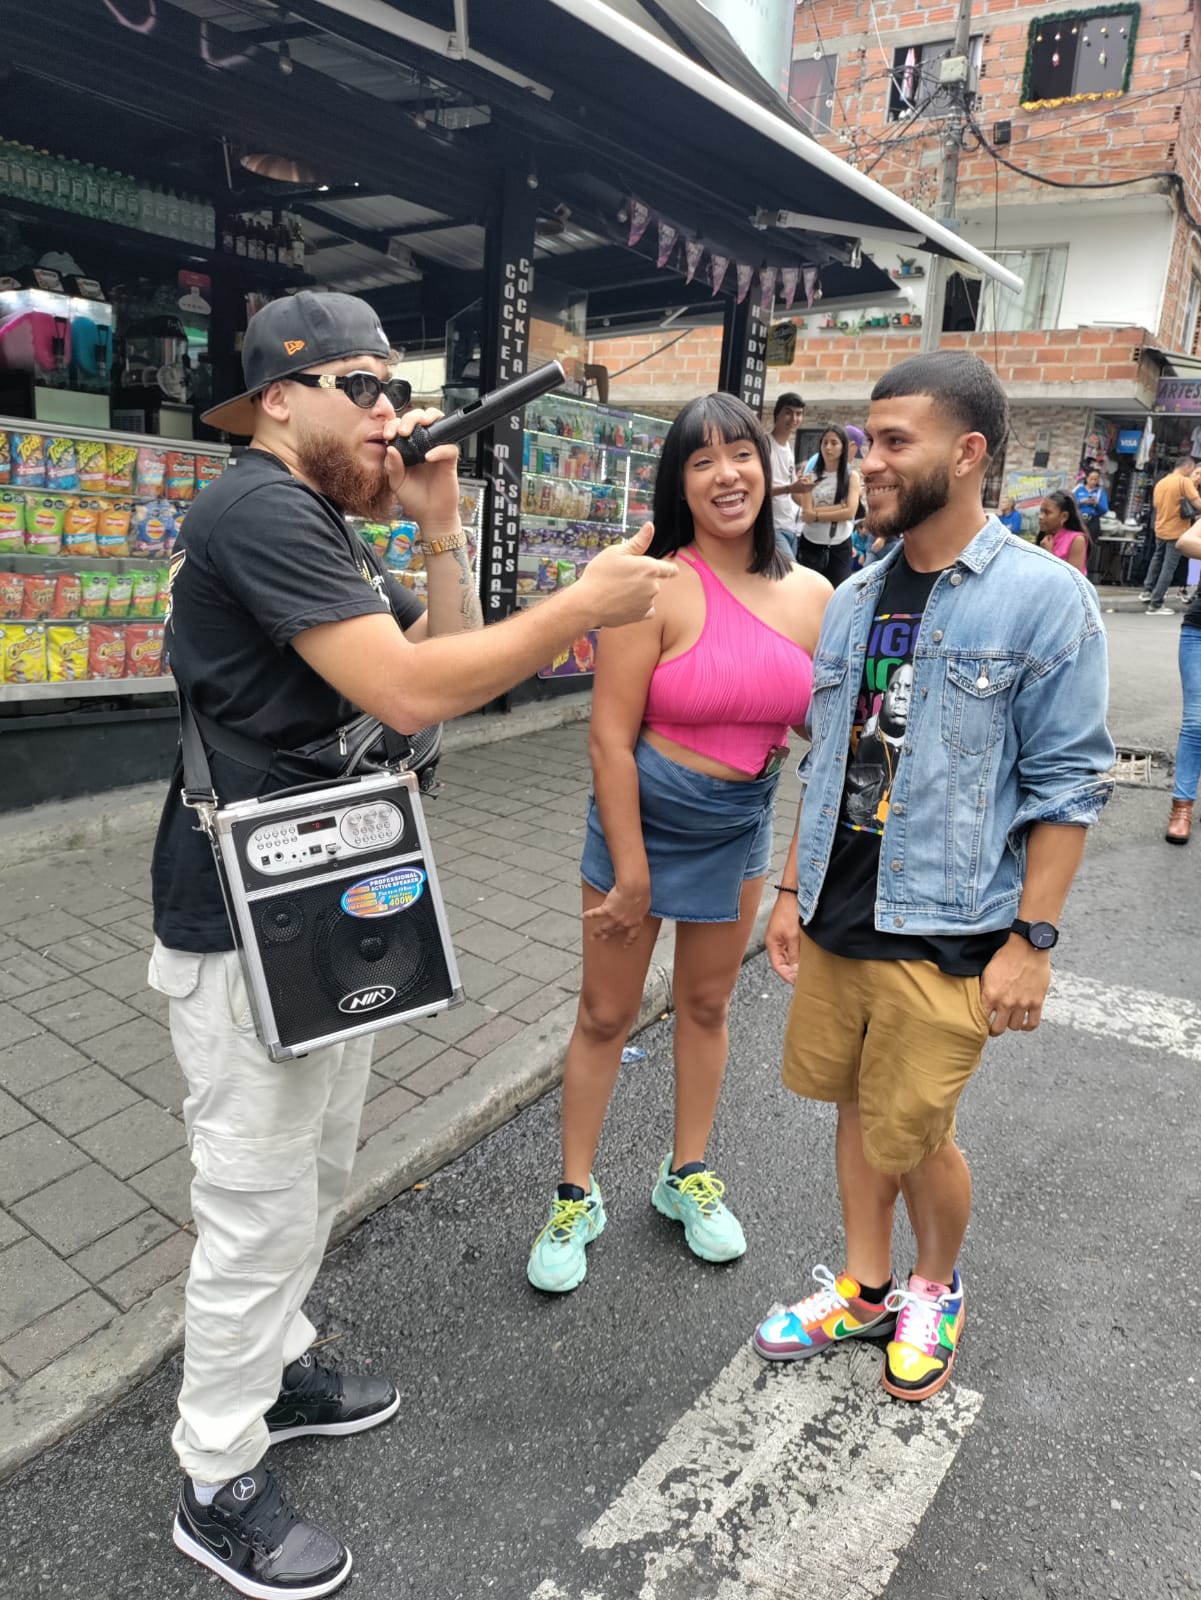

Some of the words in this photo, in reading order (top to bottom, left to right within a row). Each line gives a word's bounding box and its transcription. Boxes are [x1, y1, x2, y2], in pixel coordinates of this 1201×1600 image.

[500, 263, 516, 380] CÓCTEL
[510, 258, 529, 430] COCKTAS
[743, 305, 761, 404] HIDRAT
[751, 325, 768, 412] HYDRA
[490, 443, 510, 609] MICHELADAS
[504, 484, 519, 573] SHOTS
[370, 872, 418, 886] PROFESSIONAL
[371, 882, 392, 891] ACTIVE
[393, 877, 419, 888] SPEAKER
[389, 895, 413, 906] 400W
